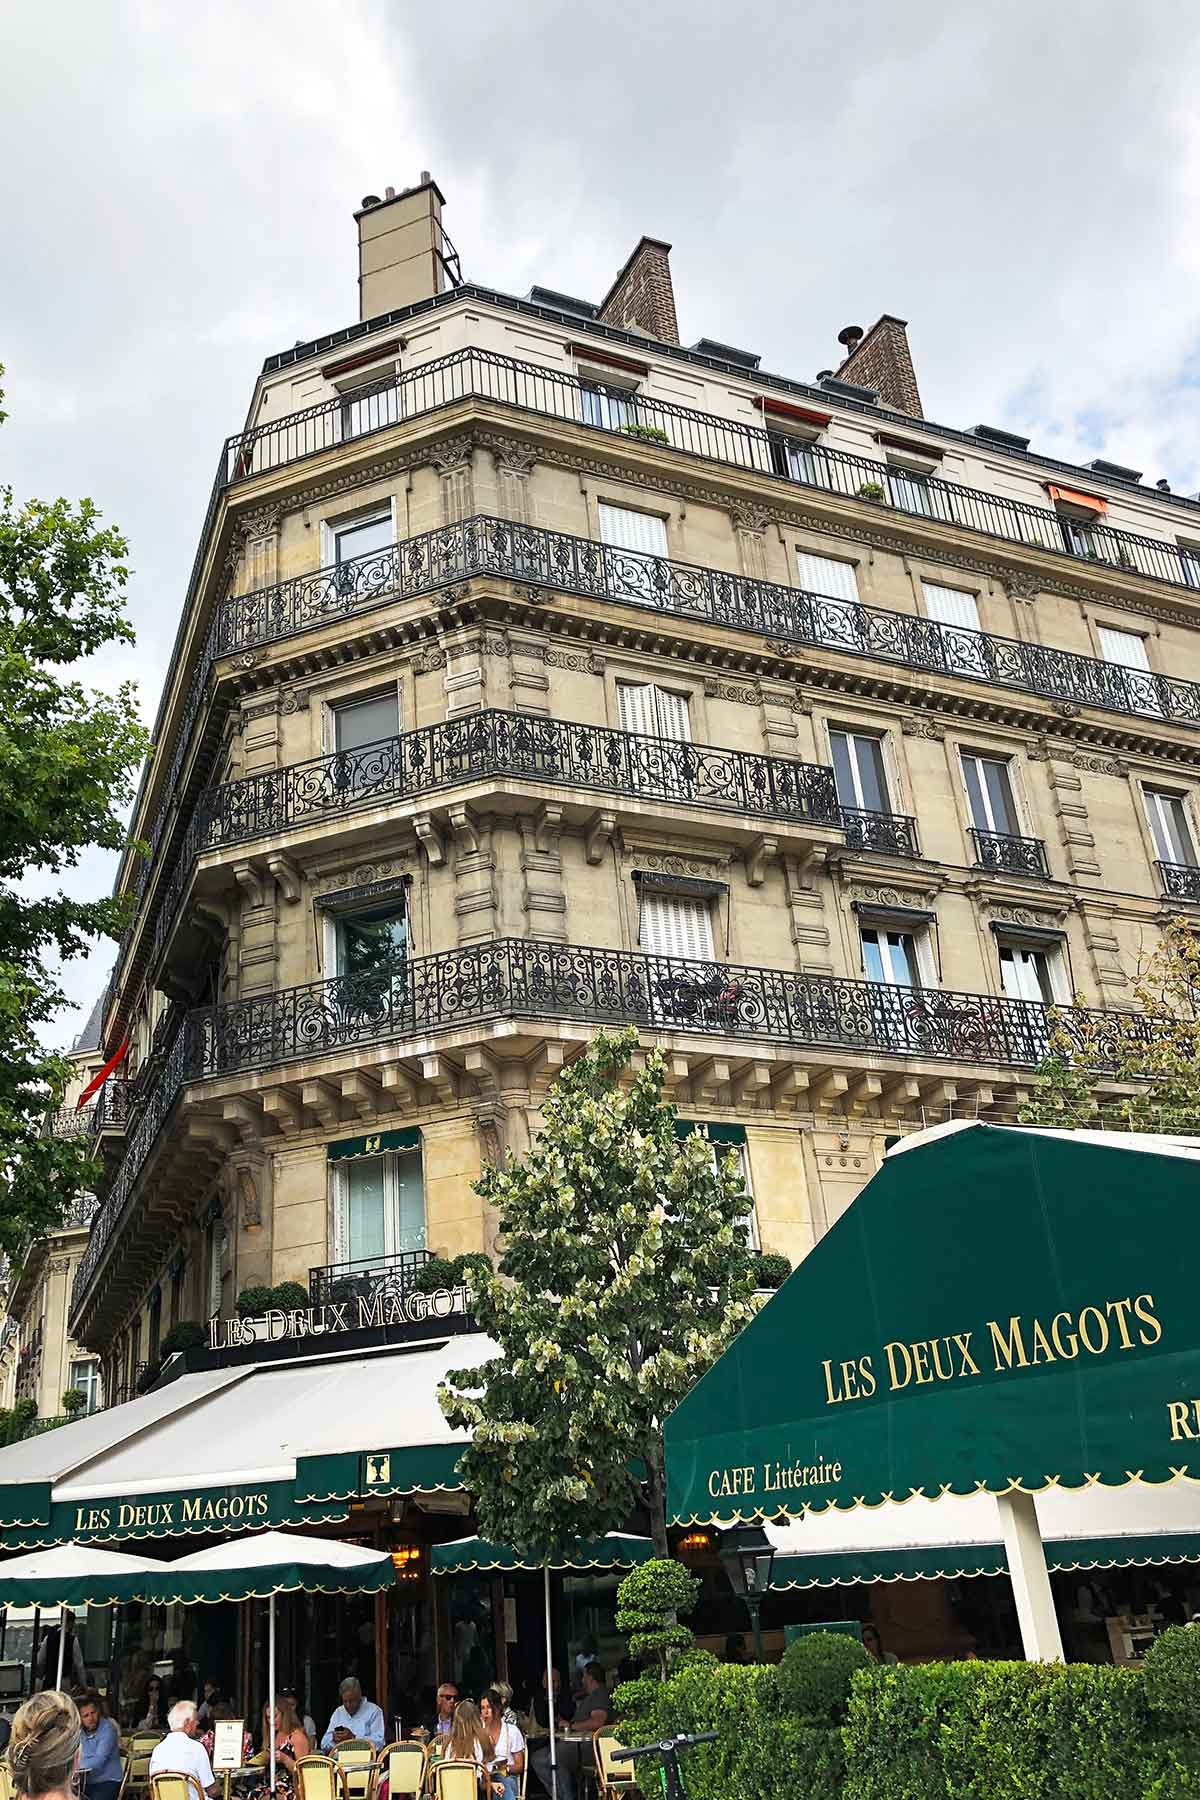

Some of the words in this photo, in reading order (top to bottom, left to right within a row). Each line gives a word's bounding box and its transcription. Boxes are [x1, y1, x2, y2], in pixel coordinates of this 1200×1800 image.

[208, 1315, 256, 1350] LES
[263, 1303, 350, 1343] DEUX
[357, 1285, 473, 1329] MAGOT
[821, 1356, 877, 1404] LES
[883, 1332, 981, 1391] DEUX
[986, 1294, 1163, 1372] MAGOTS
[708, 1466, 756, 1497] CAFE
[764, 1455, 842, 1491] Littéraire
[75, 1507, 111, 1531] LES
[117, 1503, 174, 1528] DEUX
[181, 1493, 269, 1521] MAGOTS
